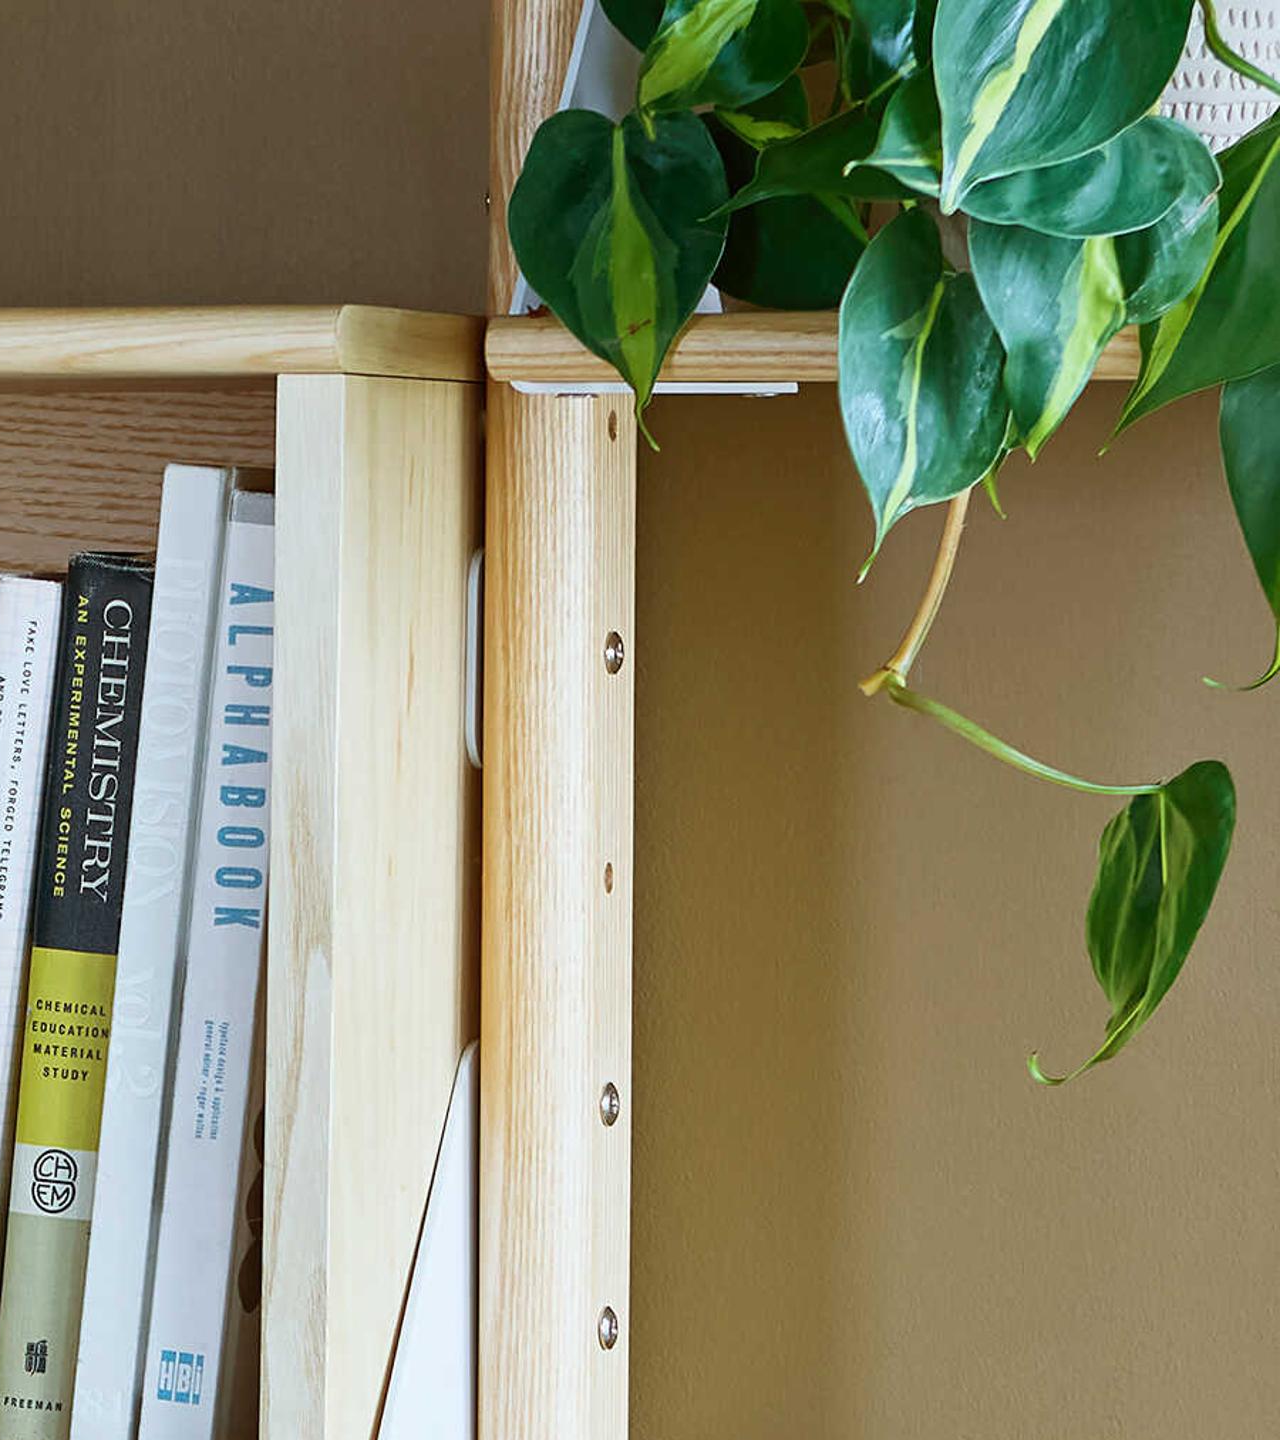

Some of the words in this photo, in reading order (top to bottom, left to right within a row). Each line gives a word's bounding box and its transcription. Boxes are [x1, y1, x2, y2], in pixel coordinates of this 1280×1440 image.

[77, 594, 90, 624] AN
[24, 620, 38, 653] FAKE
[20, 661, 33, 694] LOVE
[63, 635, 88, 794] EXPERIMENTAL
[11, 703, 27, 770] LETTERS,
[80, 599, 133, 903] CHEMISTRY
[213, 582, 275, 929] ALPHABOOK
[4, 780, 19, 832] FORGED
[53, 807, 72, 897] SCIENCE
[36, 999, 106, 1017] CHEMICAL
[32, 1020, 109, 1038] EDUCATION
[33, 1043, 102, 1061] MATERIAL
[42, 1066, 88, 1082] STUDY
[2, 1396, 63, 1412] FREEMAN
